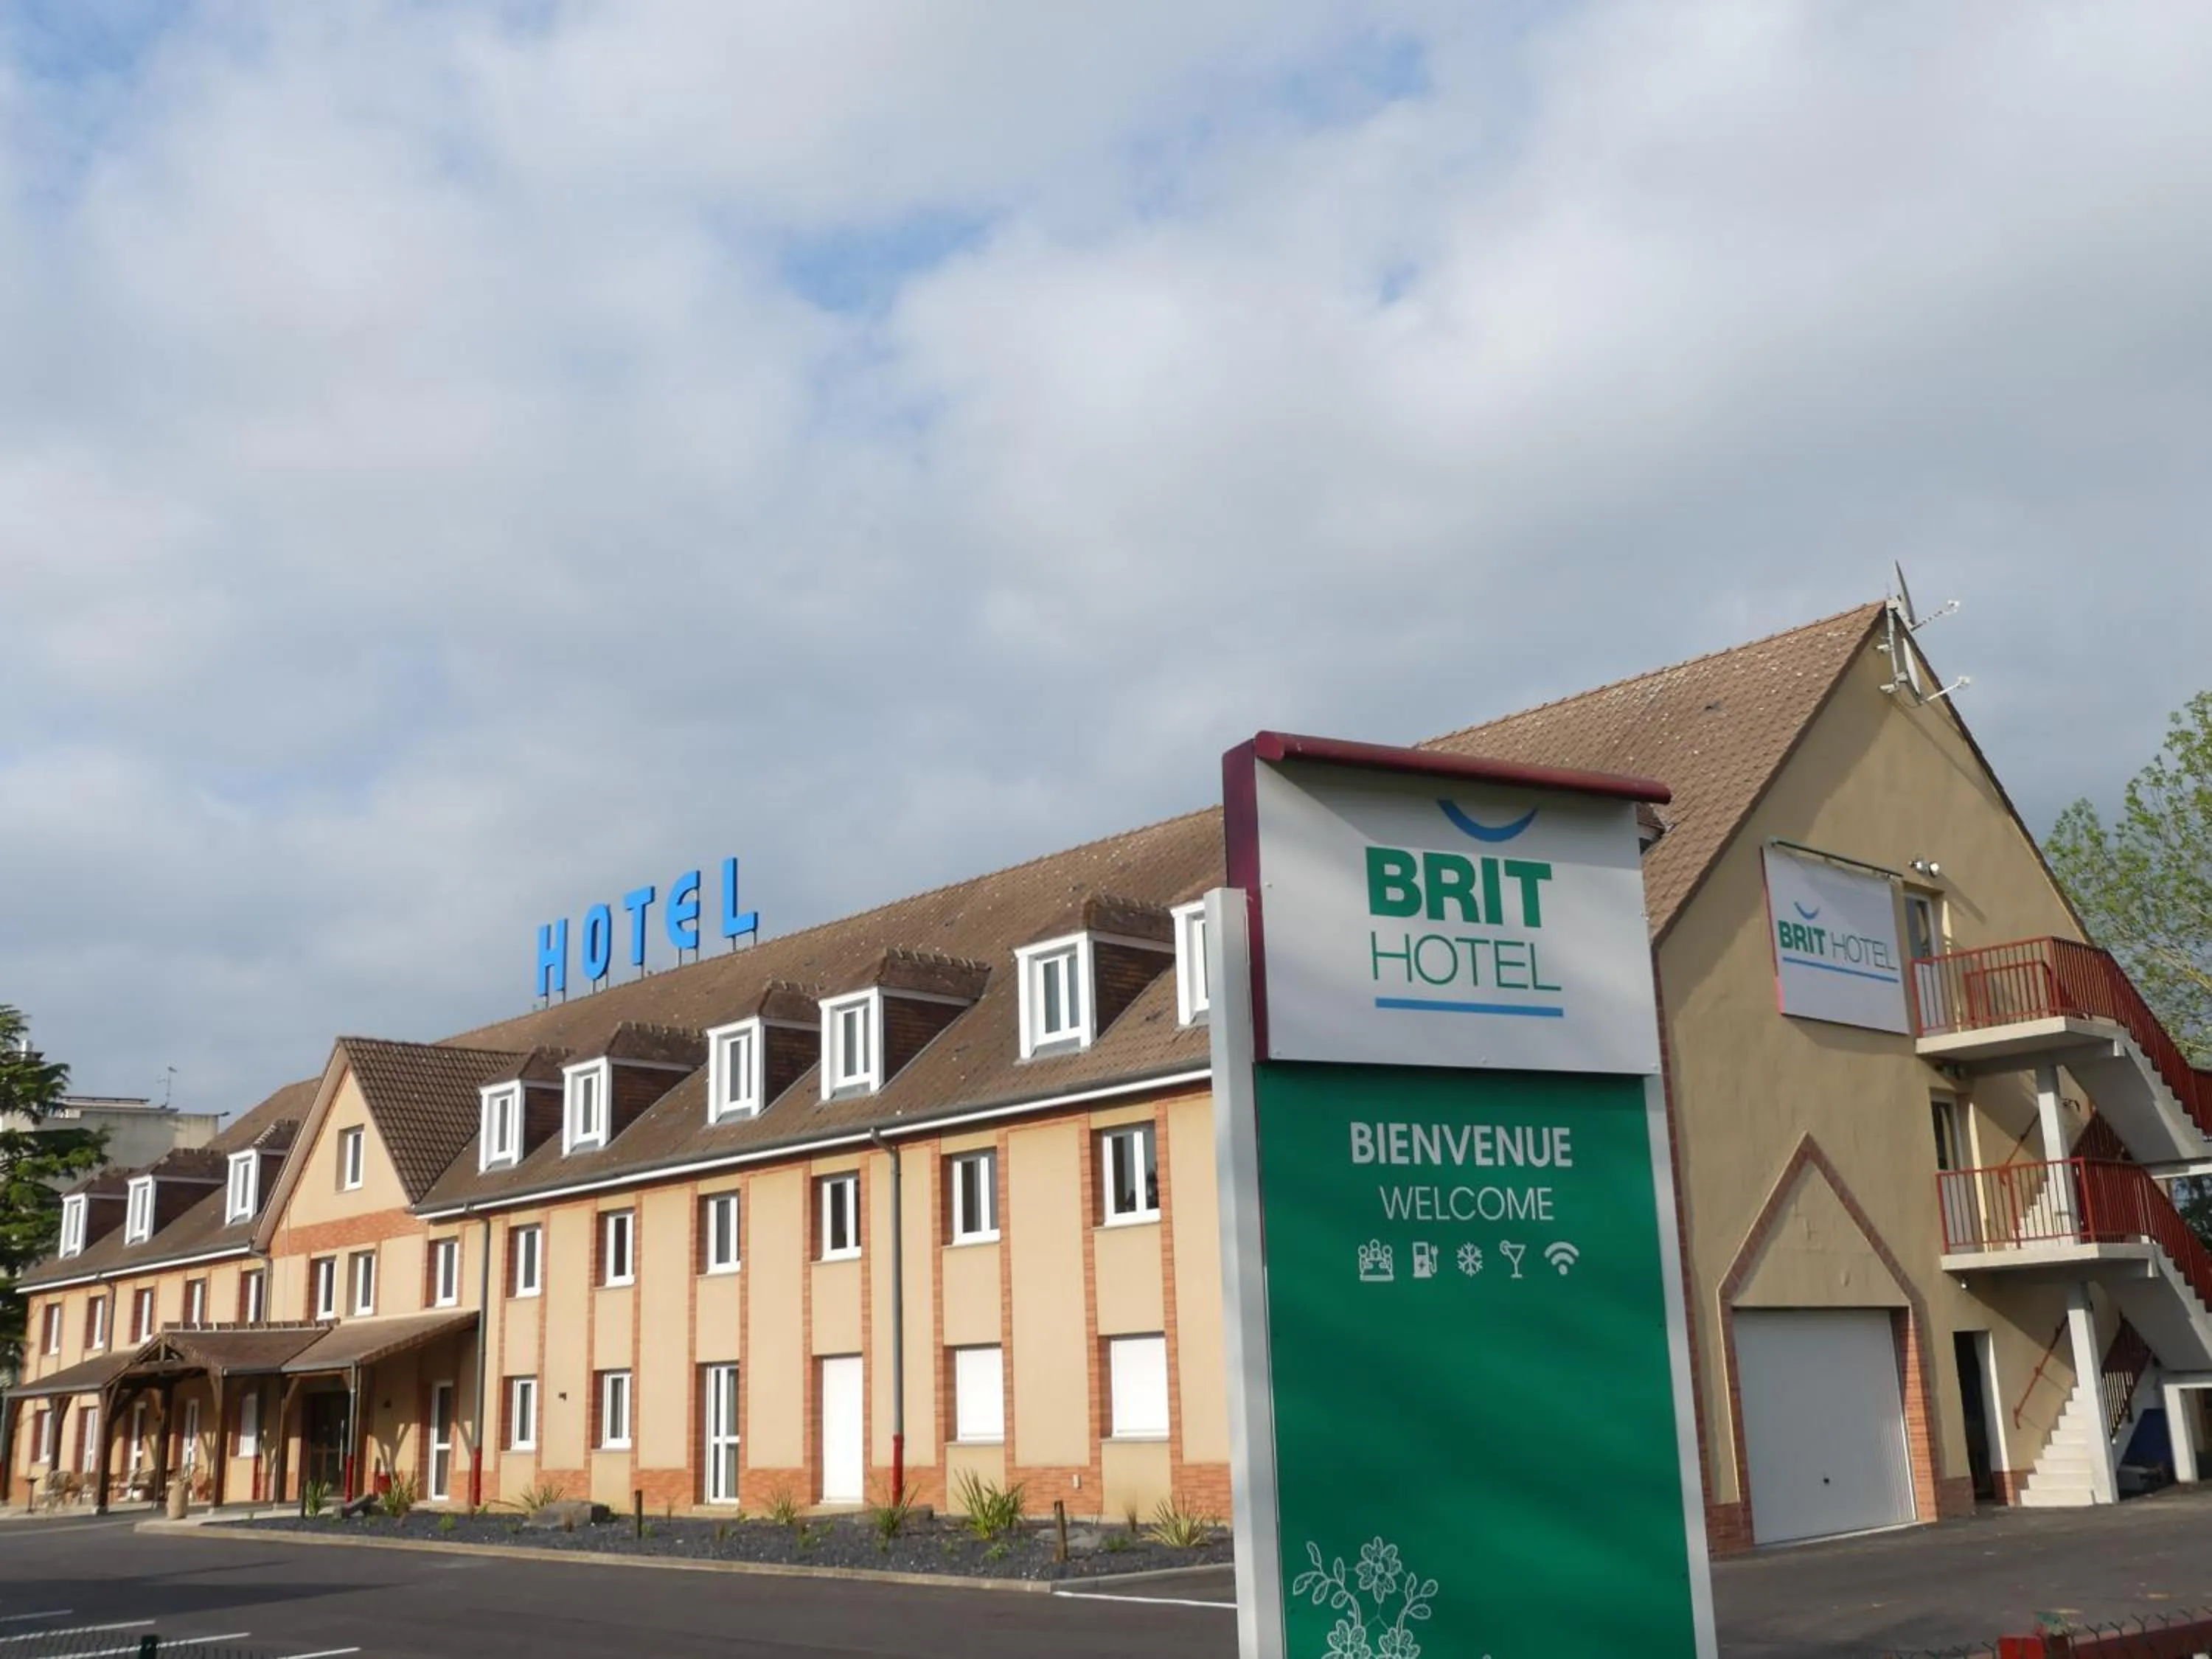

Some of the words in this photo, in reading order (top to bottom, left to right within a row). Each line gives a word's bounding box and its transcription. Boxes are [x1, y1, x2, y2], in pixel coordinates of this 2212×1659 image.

[1365, 846, 1552, 928] BRIT
[537, 857, 759, 996] HOTEL
[1778, 919, 1826, 956] BRIT
[1831, 931, 1899, 971] HOTEL
[1371, 931, 1562, 992] HOTEL
[1350, 1121, 1573, 1167] BIENVENUE
[1379, 1184, 1554, 1221] WELCOME
